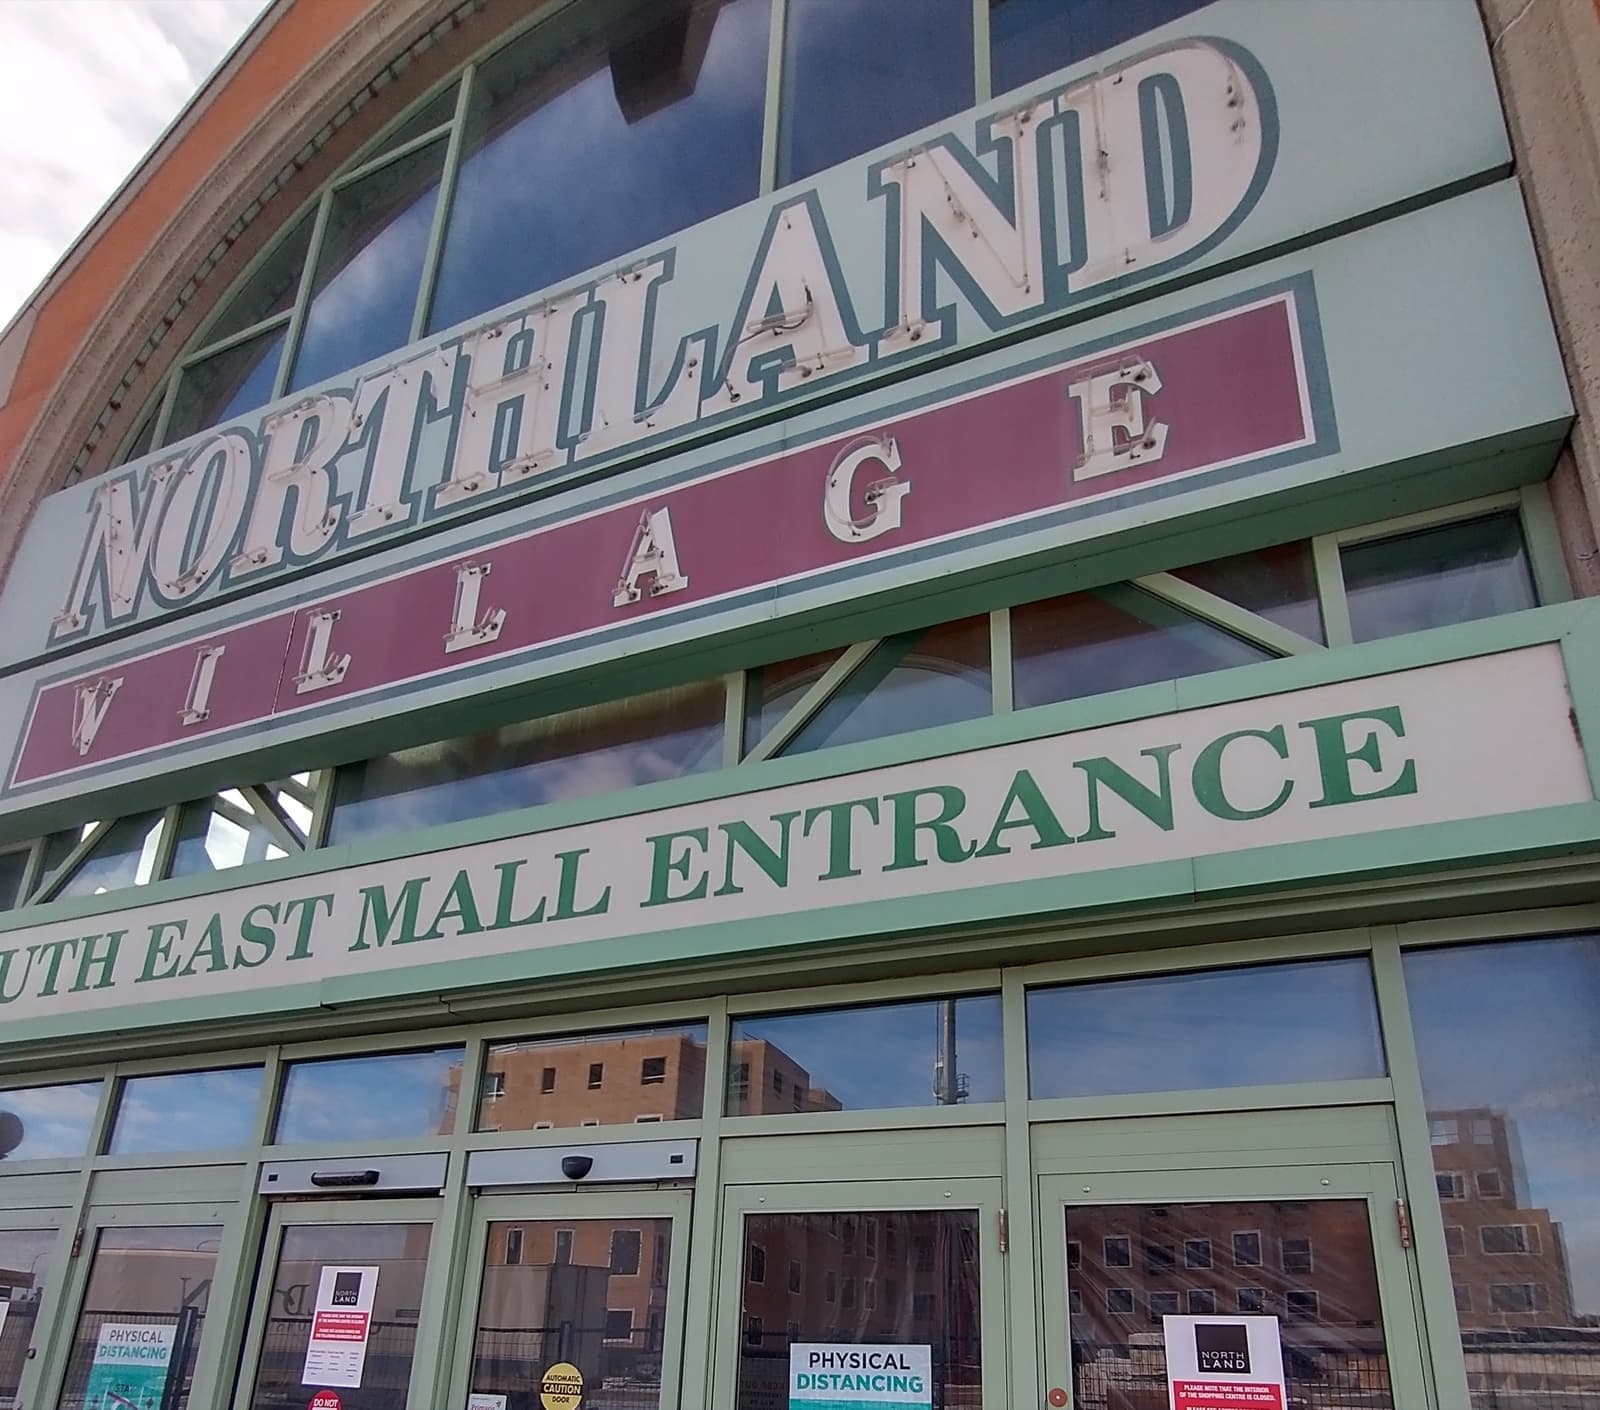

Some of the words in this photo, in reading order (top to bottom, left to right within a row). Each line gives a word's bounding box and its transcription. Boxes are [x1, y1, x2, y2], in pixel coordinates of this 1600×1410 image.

[47, 36, 1278, 645] NORTHLAND
[71, 357, 1172, 756] VILLAGE
[0, 929, 128, 1004] UTH
[134, 894, 336, 983] EAST
[347, 848, 613, 951] MALL
[639, 705, 1418, 908] ENTRANCE
[109, 1329, 164, 1343] PHYSICAL
[99, 1345, 167, 1360] DISTANCING
[1202, 1351, 1245, 1359] NORTH
[808, 1352, 911, 1370] PHYSICAL
[1203, 1359, 1246, 1369] LAND
[546, 1374, 581, 1383] AUTOMATIC
[796, 1373, 924, 1393] DISTANCING
[543, 1383, 581, 1395] CAUTION
[313, 1398, 324, 1407] DO
[324, 1398, 339, 1407] NOT
[552, 1395, 570, 1403] DOOR
